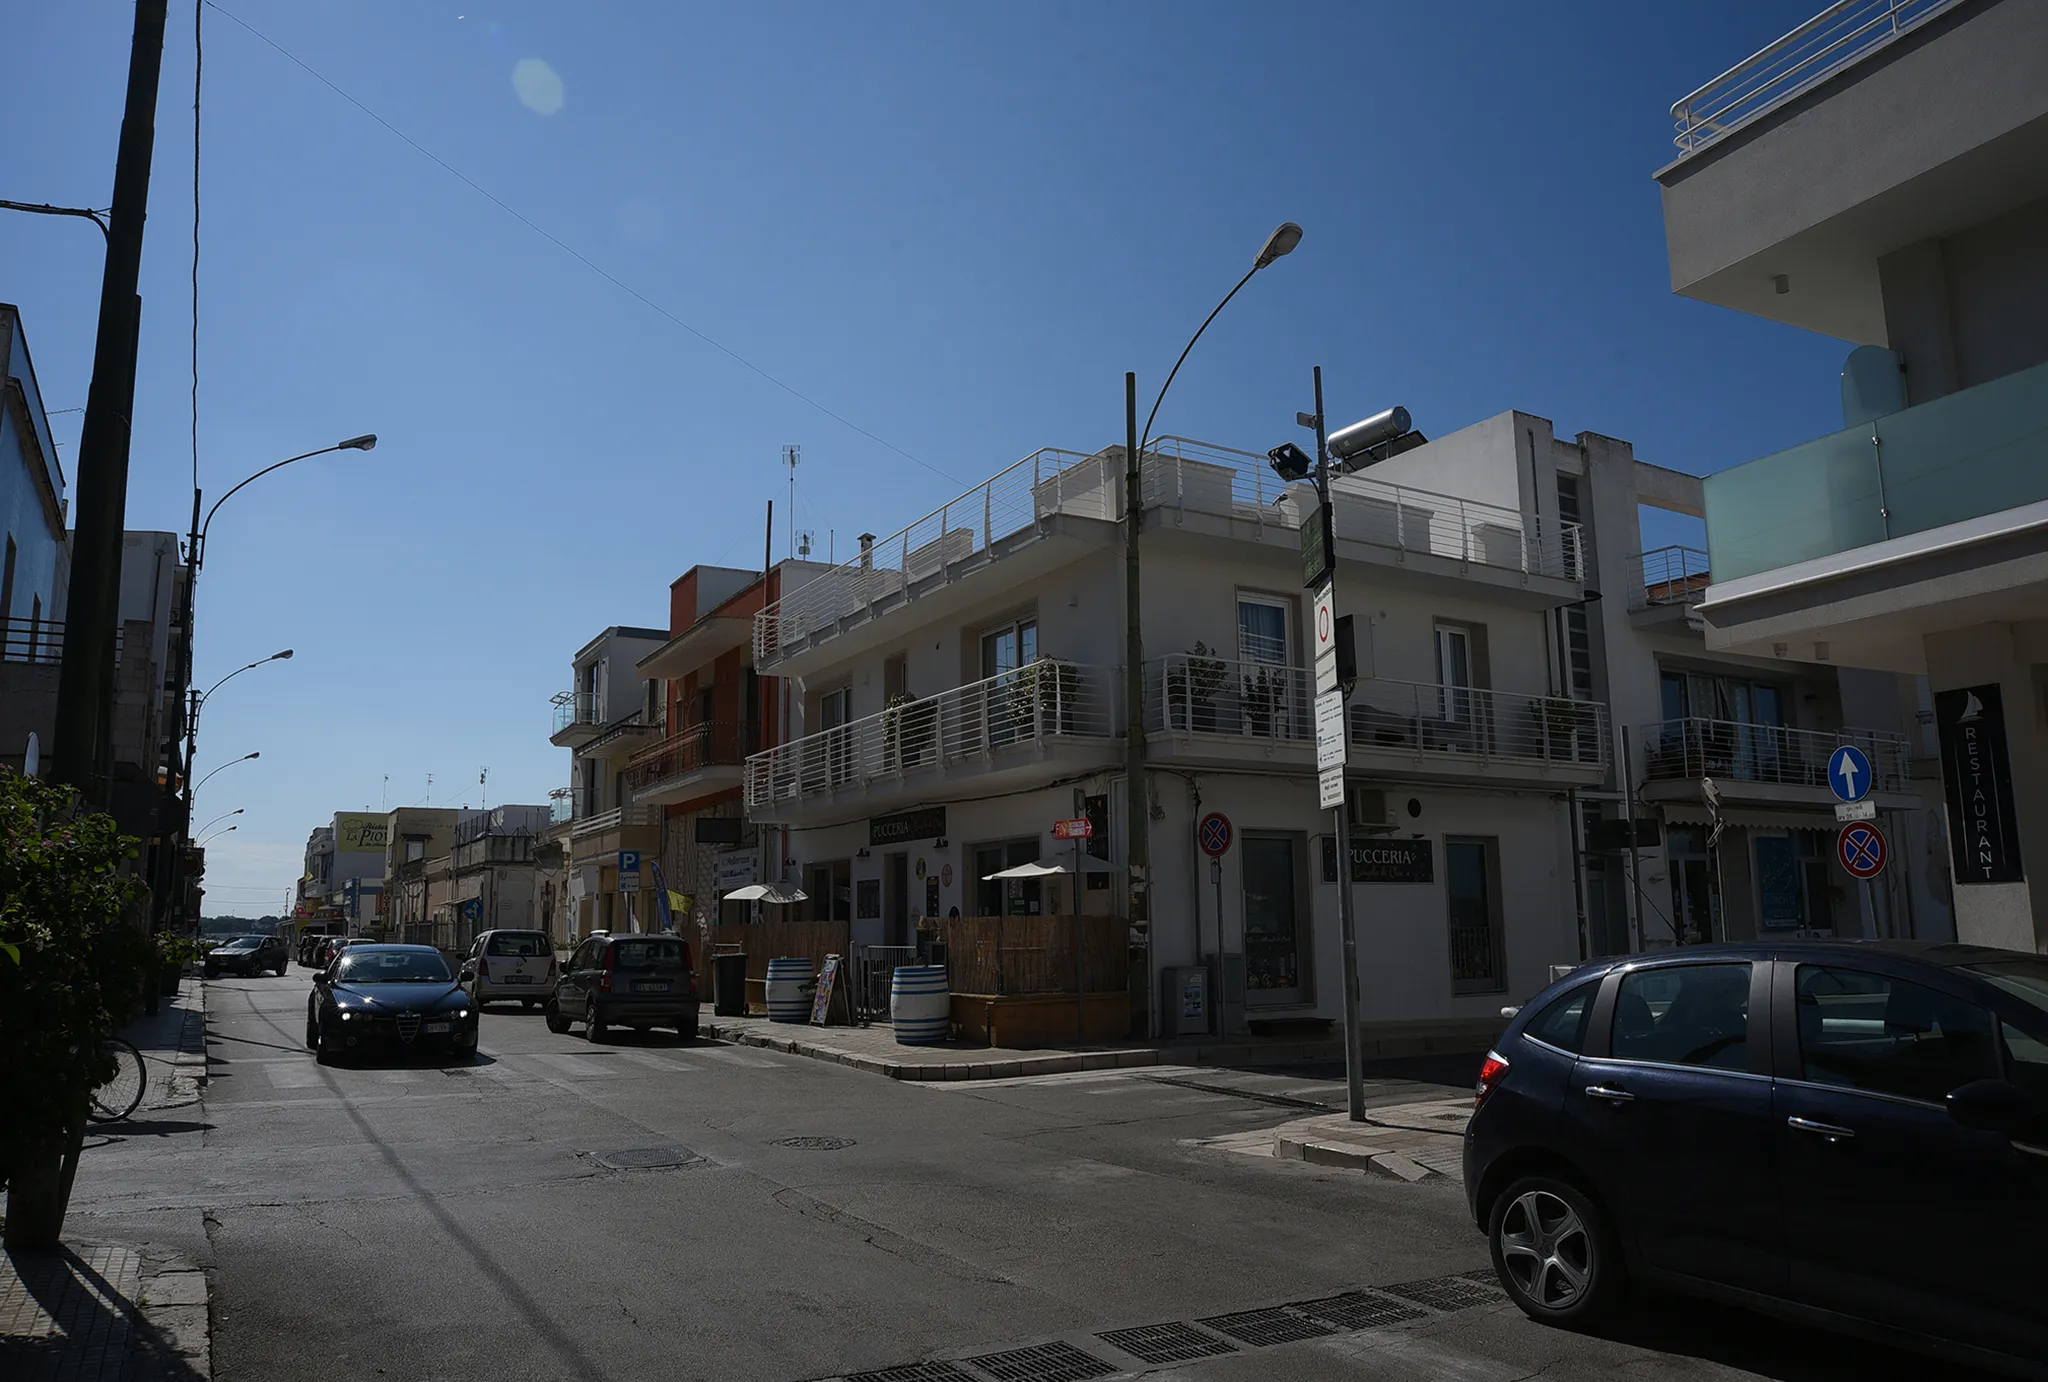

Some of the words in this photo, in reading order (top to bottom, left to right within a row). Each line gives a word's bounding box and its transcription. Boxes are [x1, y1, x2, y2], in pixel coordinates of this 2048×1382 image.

[1964, 727, 1993, 880] RESTAURANT
[873, 821, 909, 838] PUCCERIA
[623, 853, 636, 869] P
